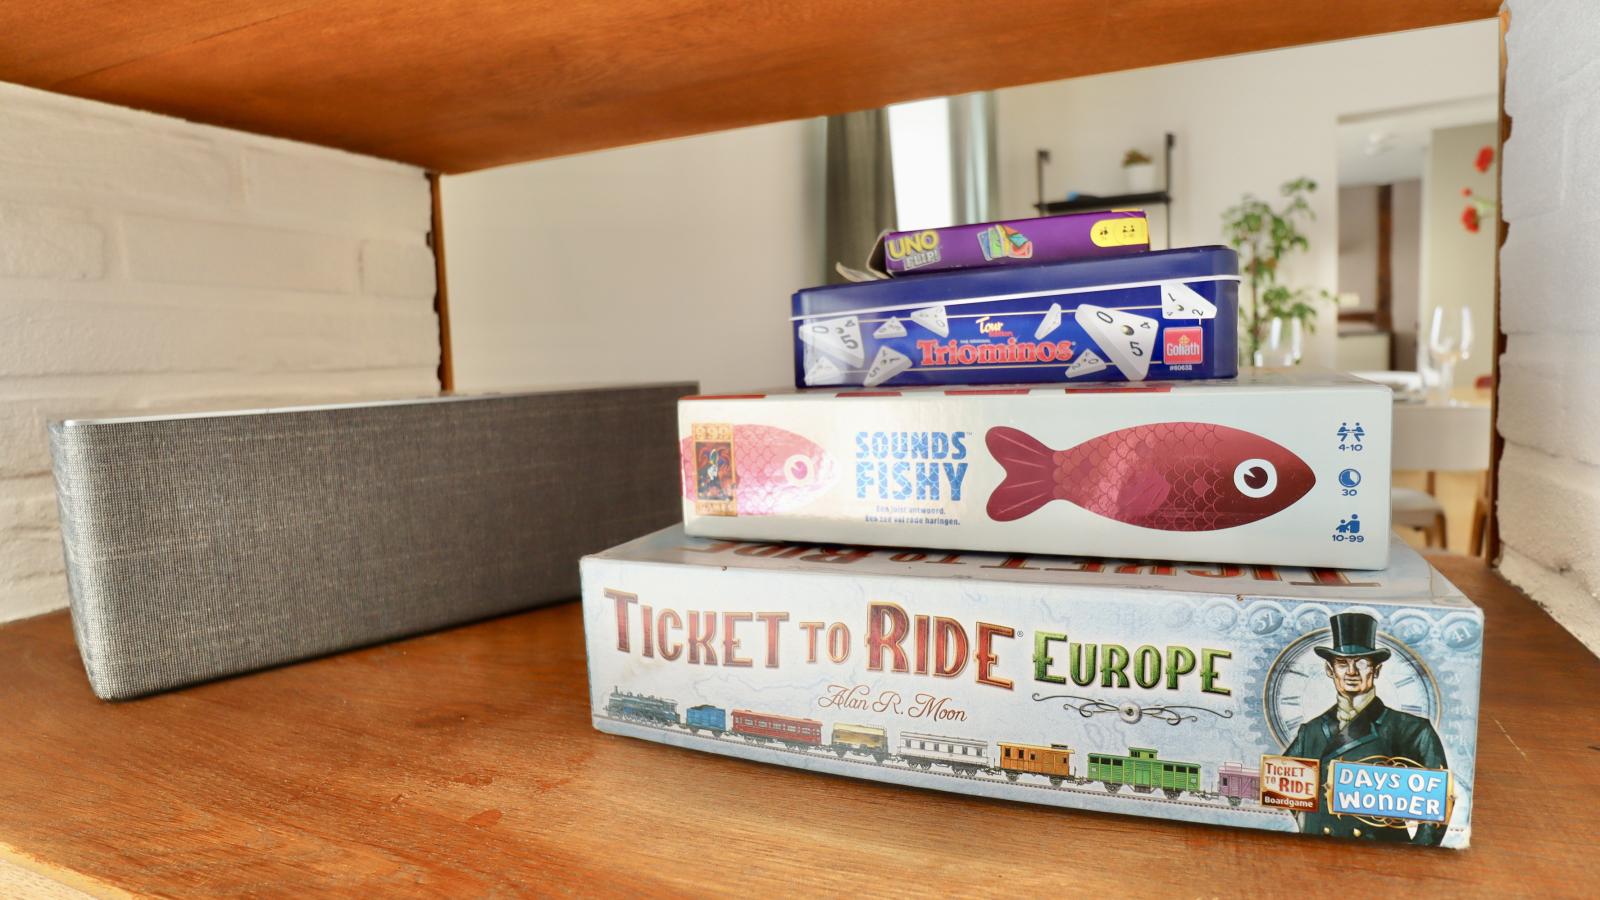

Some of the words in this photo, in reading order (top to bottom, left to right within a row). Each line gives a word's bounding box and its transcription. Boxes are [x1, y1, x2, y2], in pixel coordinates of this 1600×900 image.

[888, 230, 939, 259] UNO
[905, 250, 938, 269] FLIP!
[975, 316, 1004, 334] Tour
[916, 337, 1074, 366] Triominos
[1166, 342, 1200, 356] Goliath
[855, 431, 967, 460] SOUNDS
[1338, 443, 1363, 452] 4-10
[856, 462, 969, 501] FISHY
[1341, 489, 1358, 497] 30
[924, 517, 960, 526] haringen.
[1332, 535, 1364, 543] 10-99
[603, 587, 790, 668] TICKET
[799, 621, 851, 664] TO
[1032, 630, 1233, 697] EUROPE
[817, 684, 869, 712] Alan
[868, 688, 904, 716] R.
[905, 697, 968, 724] Moon
[1264, 762, 1305, 777] TICKET
[1264, 776, 1277, 785] TO
[1278, 777, 1315, 796] RIDE
[1339, 767, 1401, 791] DAYS
[1408, 774, 1442, 794] OF
[1264, 796, 1313, 808] Boardgame
